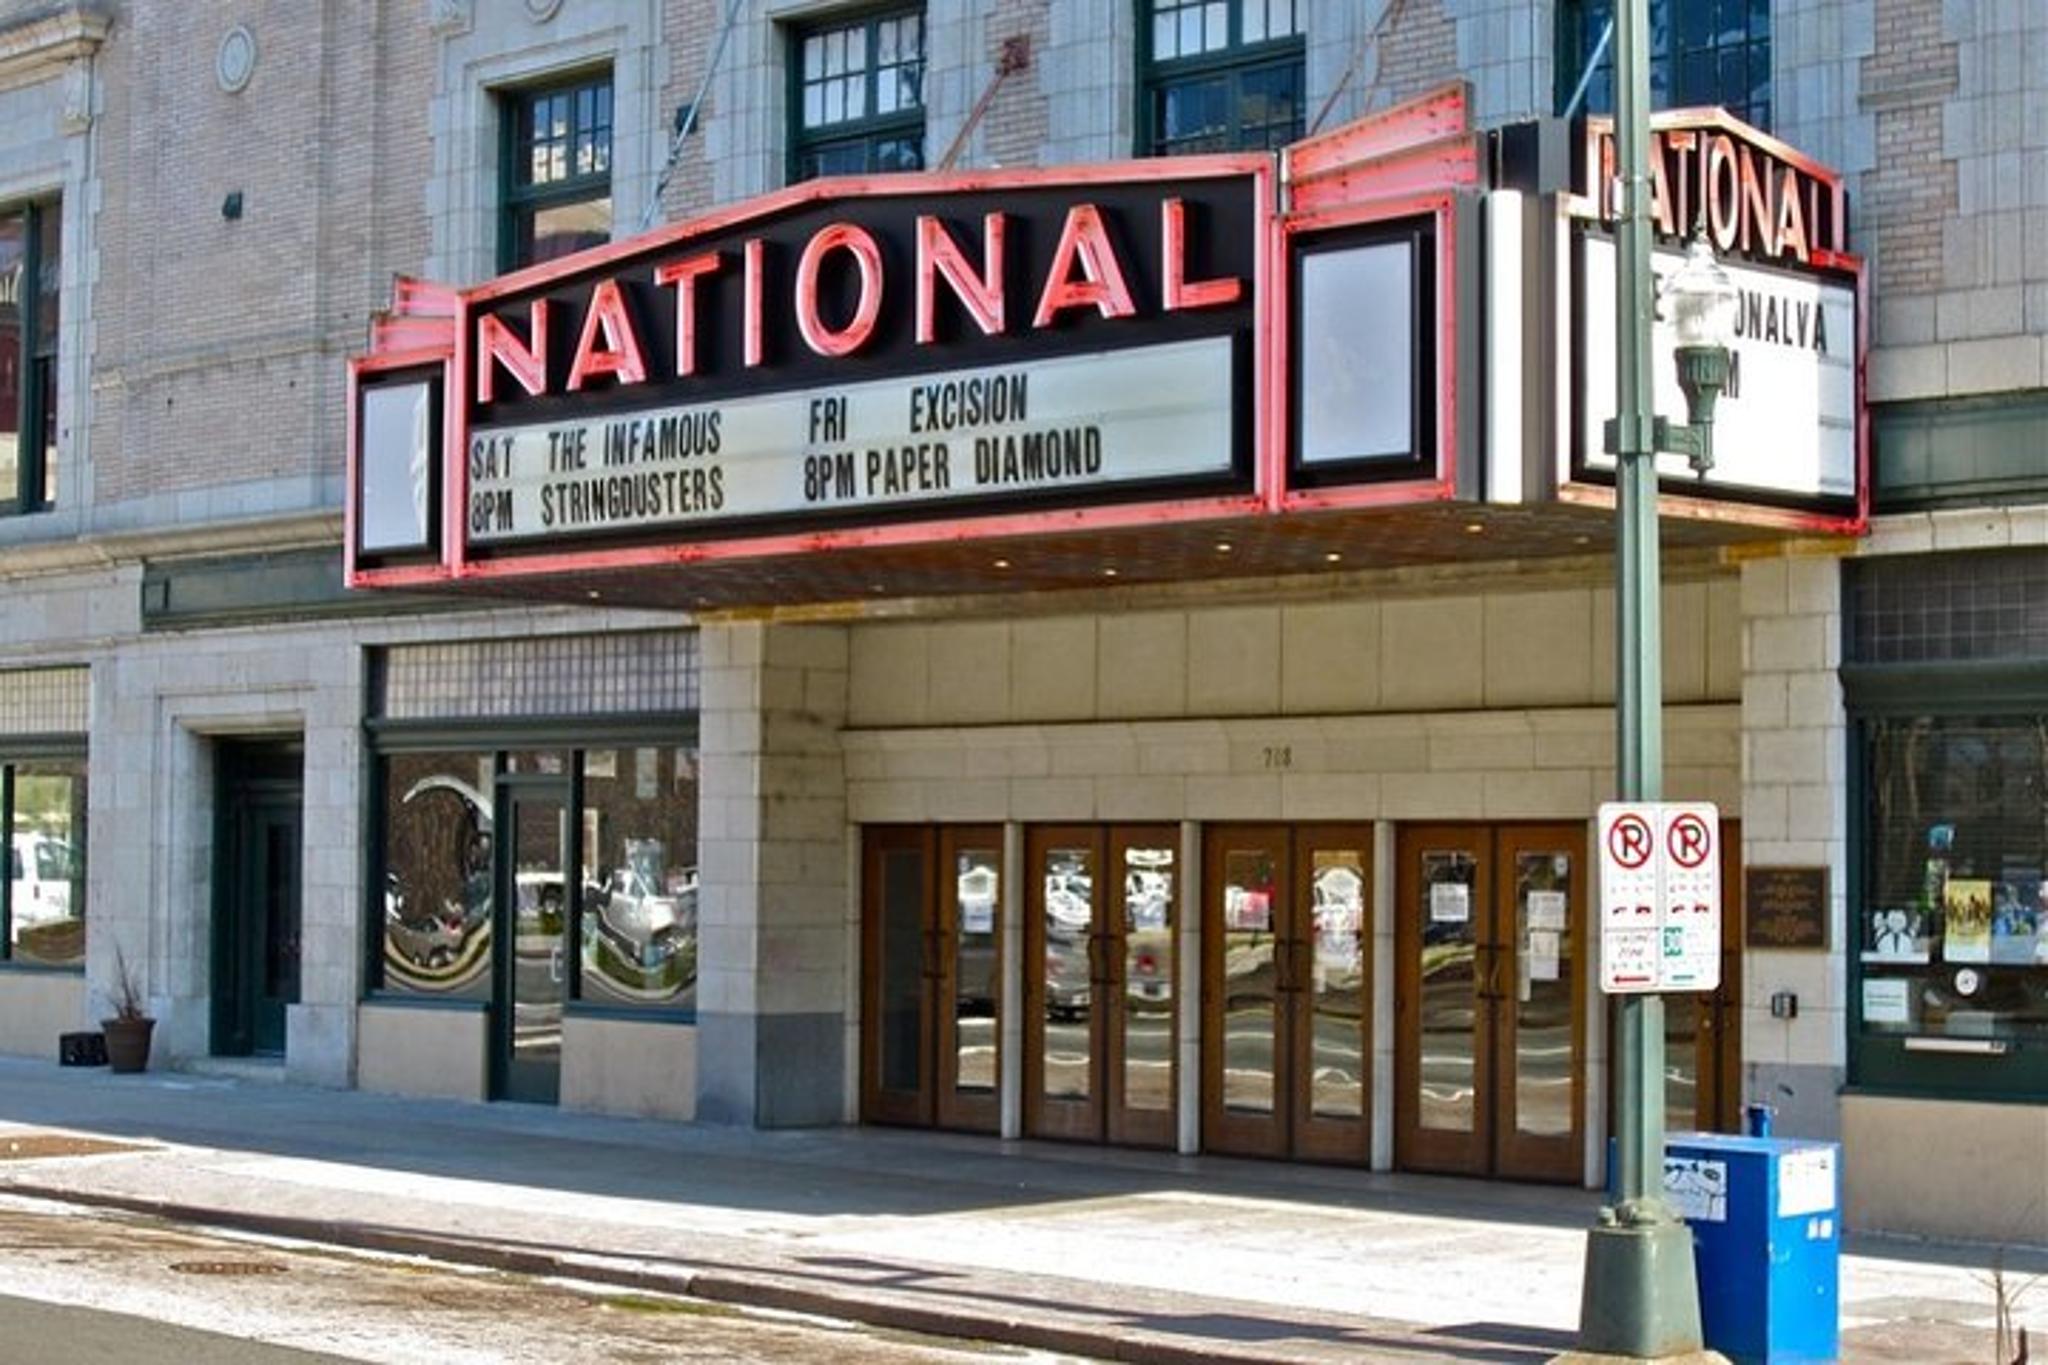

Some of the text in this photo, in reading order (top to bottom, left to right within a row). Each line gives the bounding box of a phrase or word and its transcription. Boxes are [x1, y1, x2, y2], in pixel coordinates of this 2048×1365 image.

[478, 197, 1242, 403] NATIONAL
[810, 372, 1028, 444] FRI EXCISION
[471, 410, 722, 480] SAT THE INFAMOUS
[804, 427, 1101, 501] 8PM PAPER DIAMOND
[471, 466, 723, 533] 8PM STRINGDUSTERS
